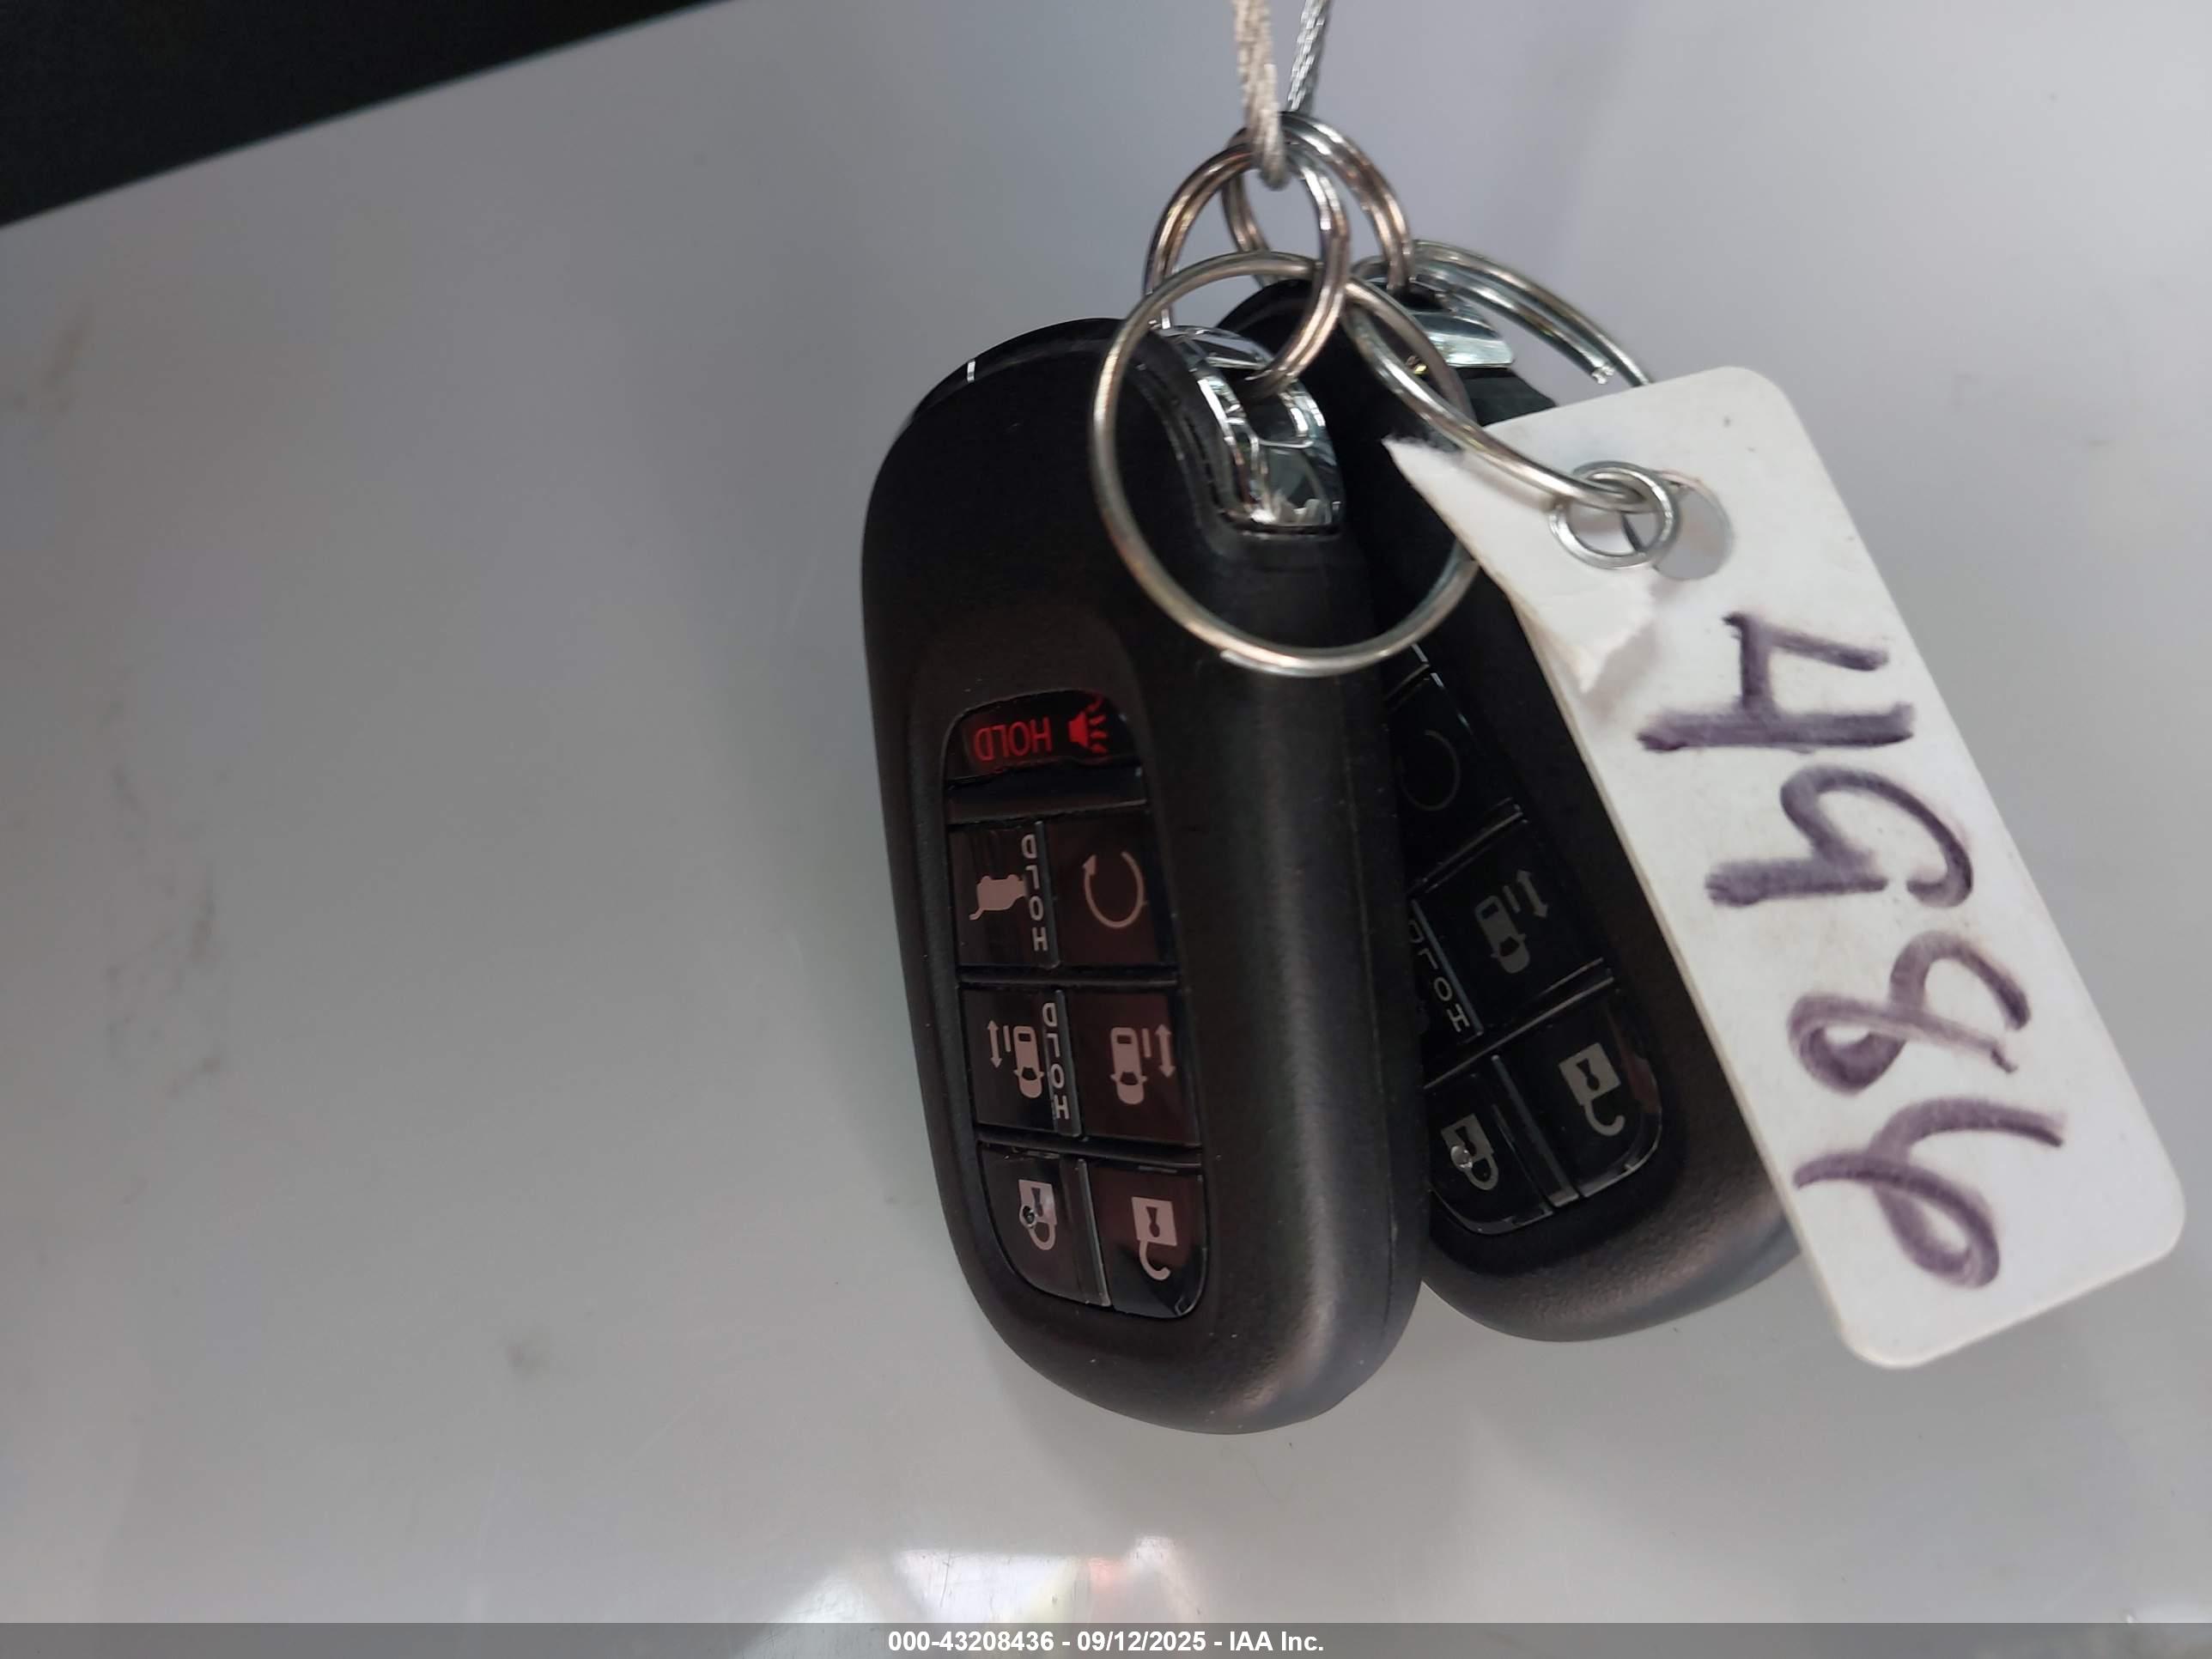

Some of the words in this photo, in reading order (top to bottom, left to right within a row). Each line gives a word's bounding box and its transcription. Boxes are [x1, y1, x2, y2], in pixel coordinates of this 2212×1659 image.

[974, 716, 1054, 763] HOLD
[1021, 833, 1049, 952] HOLD
[1042, 1001, 1071, 1121] HOLD
